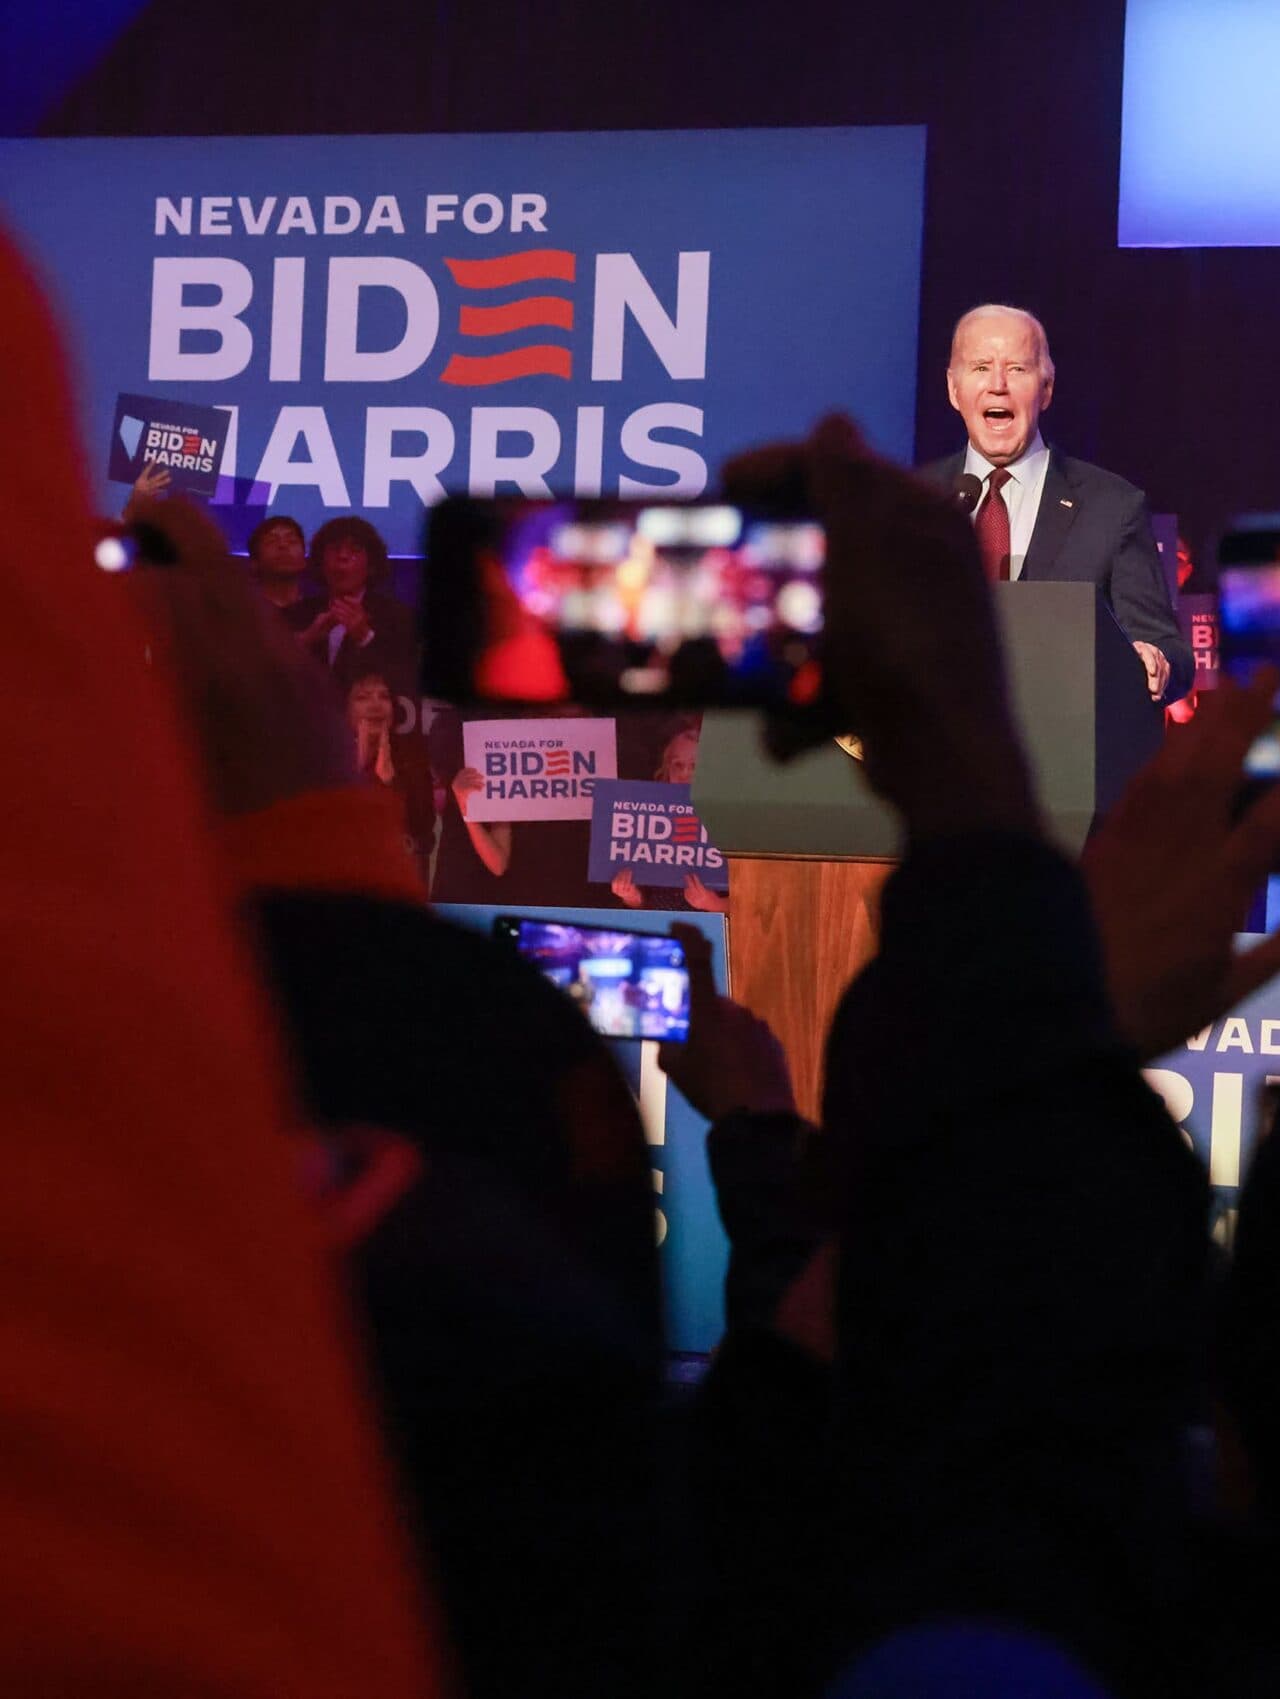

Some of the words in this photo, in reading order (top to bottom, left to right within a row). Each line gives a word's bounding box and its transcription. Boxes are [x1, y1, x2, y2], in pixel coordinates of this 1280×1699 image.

[154, 196, 405, 235] NEVADA
[425, 192, 548, 233] FOR
[148, 249, 711, 386] BIDEN
[150, 421, 181, 433] NEVADA
[182, 426, 199, 435] FOR
[146, 429, 217, 457] BIDEN
[144, 448, 213, 473] HARRIS
[484, 741, 535, 749] NEVADA
[539, 740, 563, 748] FOR
[485, 750, 596, 776] BIDEN
[486, 778, 596, 799] HARRIS
[613, 801, 665, 812] NEVADA
[669, 805, 694, 815] FOR
[609, 841, 724, 868] HARRIS
